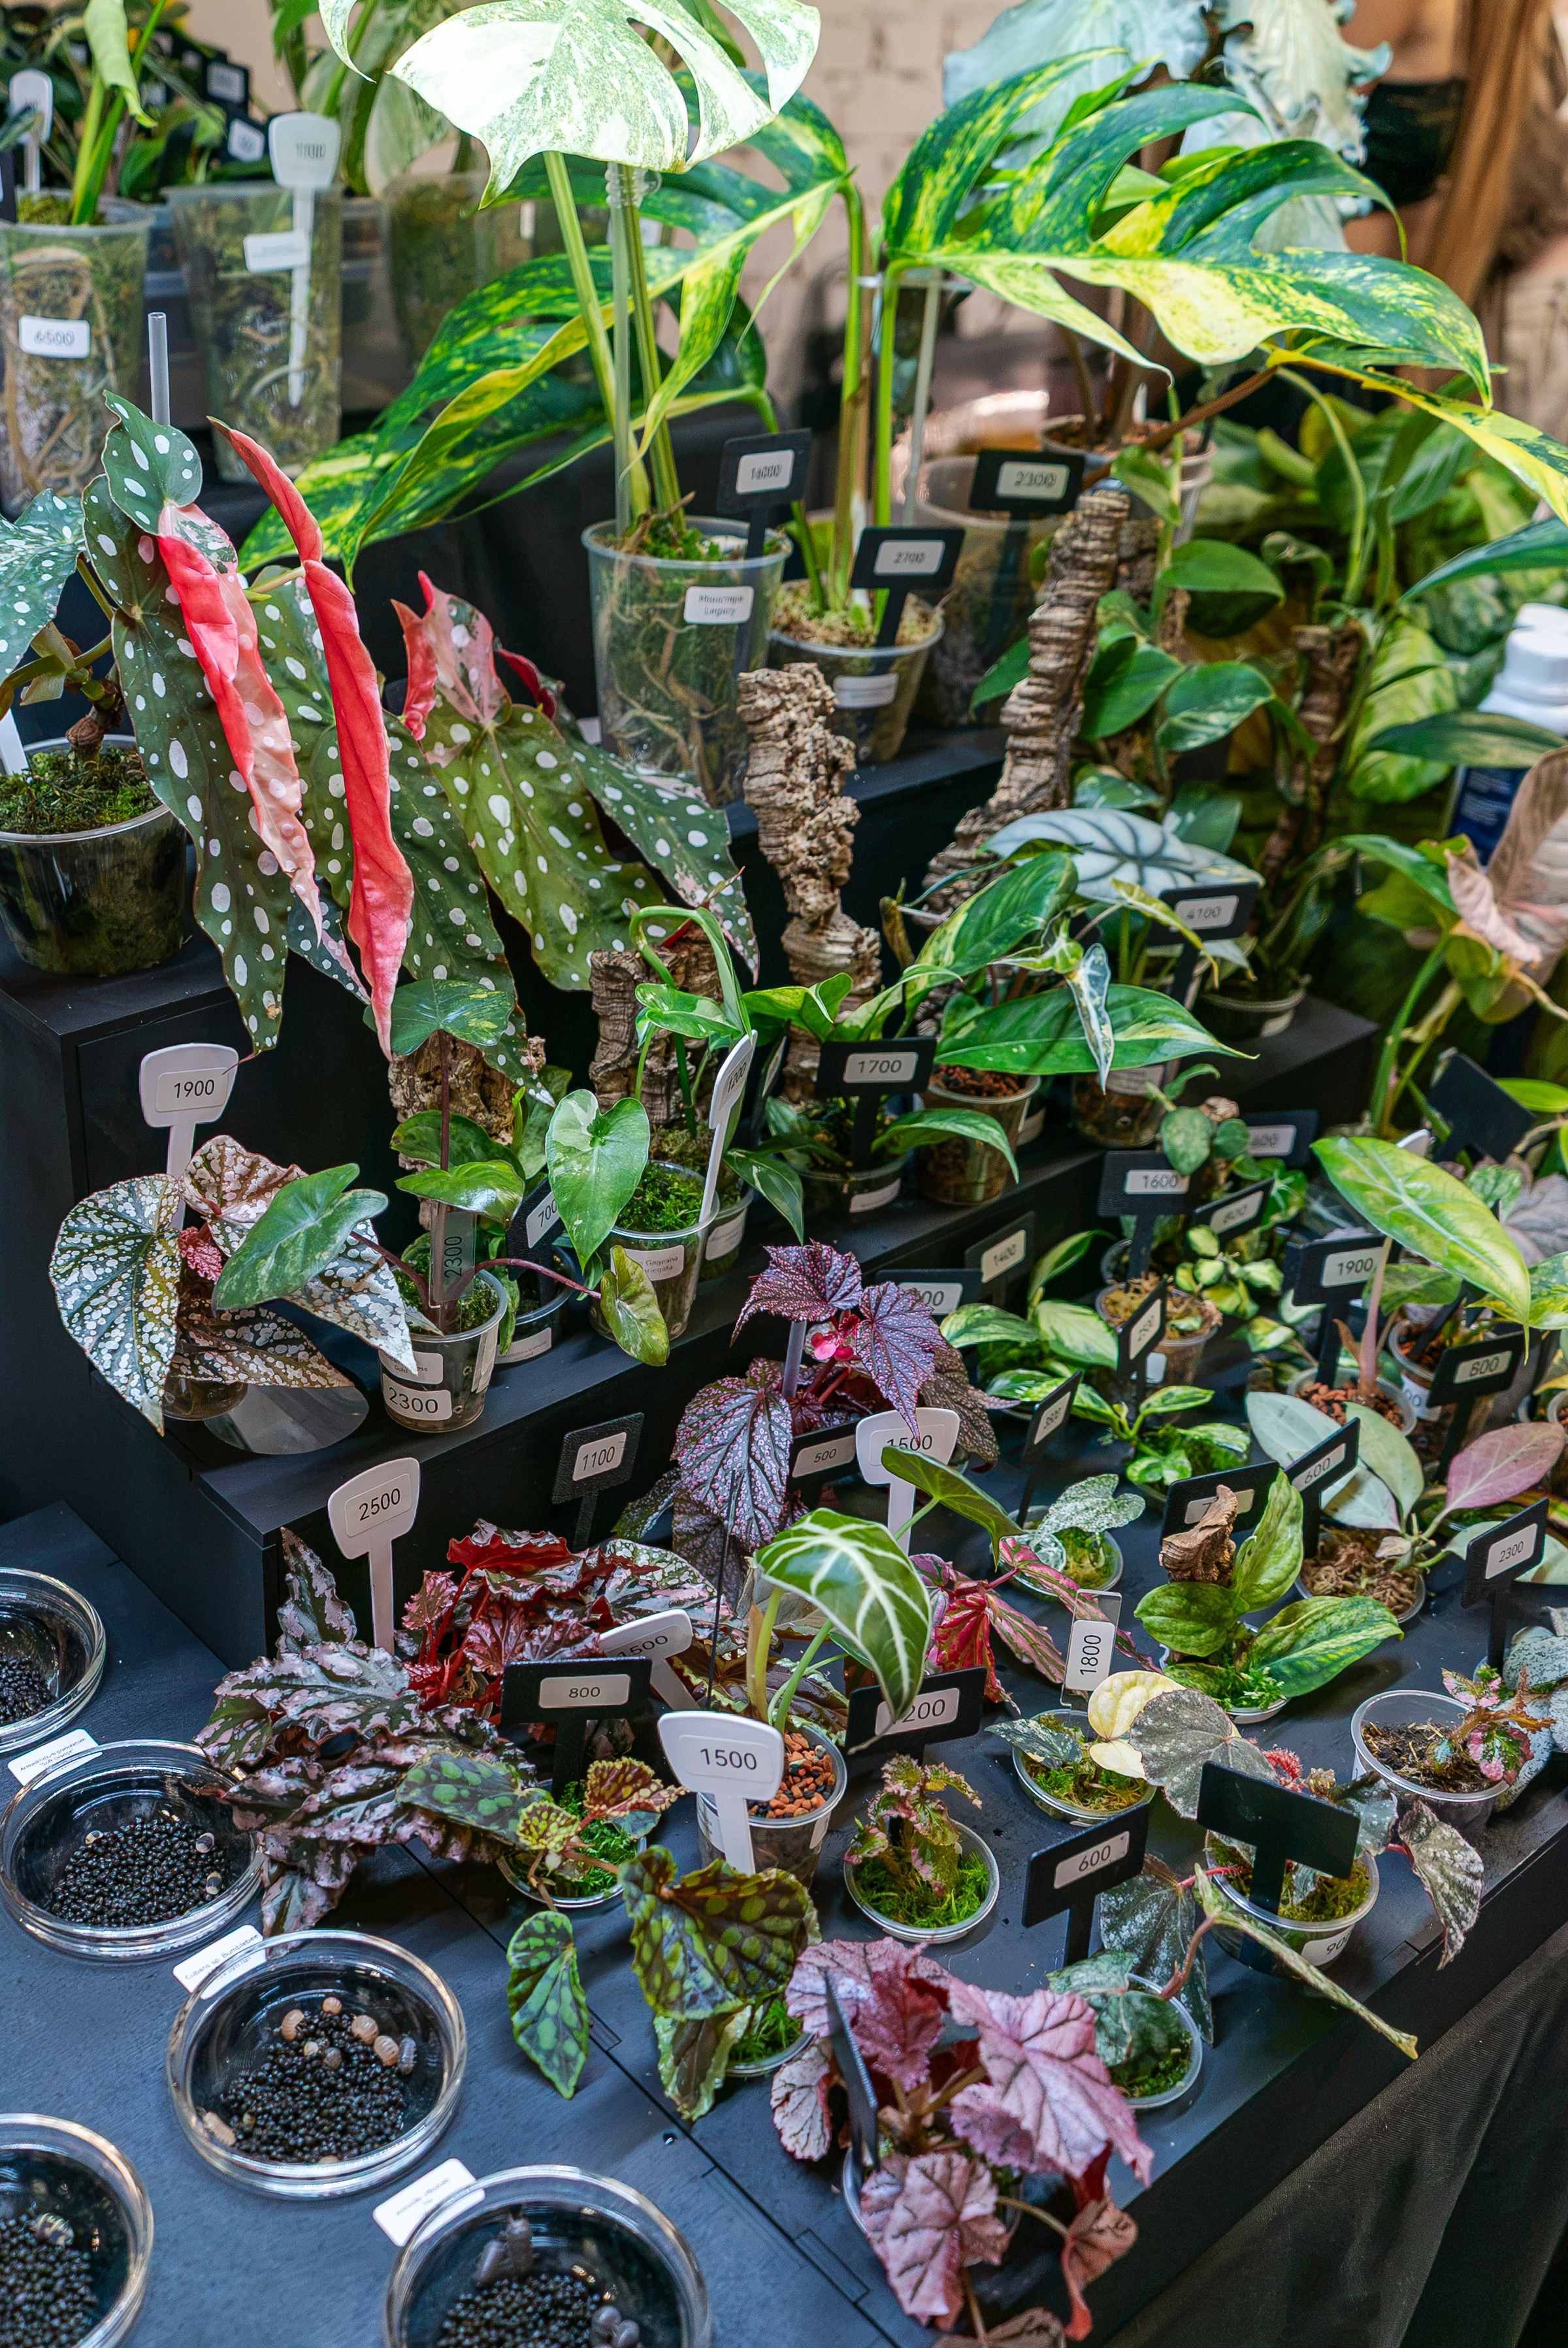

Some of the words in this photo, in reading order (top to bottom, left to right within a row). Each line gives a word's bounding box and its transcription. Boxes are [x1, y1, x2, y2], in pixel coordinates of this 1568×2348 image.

[727, 1061, 747, 1091] 1200
[858, 1059, 902, 1074] 1700
[174, 1079, 215, 1099] 1900
[1142, 1175, 1179, 1189] 1600
[538, 1199, 558, 1227] 700
[444, 1236, 463, 1278] 2300
[1337, 1257, 1373, 1276] 1900
[920, 1290, 945, 1306] 00
[389, 1387, 438, 1414] 2300
[886, 1434, 933, 1451] 1500
[583, 1446, 615, 1472] 1100
[813, 1448, 837, 1463] 500
[1304, 1457, 1331, 1484] 600
[359, 1488, 400, 1522] 2500
[1498, 1541, 1524, 1563] 2300
[1079, 1634, 1102, 1676] 1800
[568, 1687, 600, 1698] 800
[901, 1698, 945, 1723] 200
[700, 1748, 757, 1770] 1500
[1078, 1845, 1111, 1872] 600
[221, 1934, 259, 1959] Bumblebee
